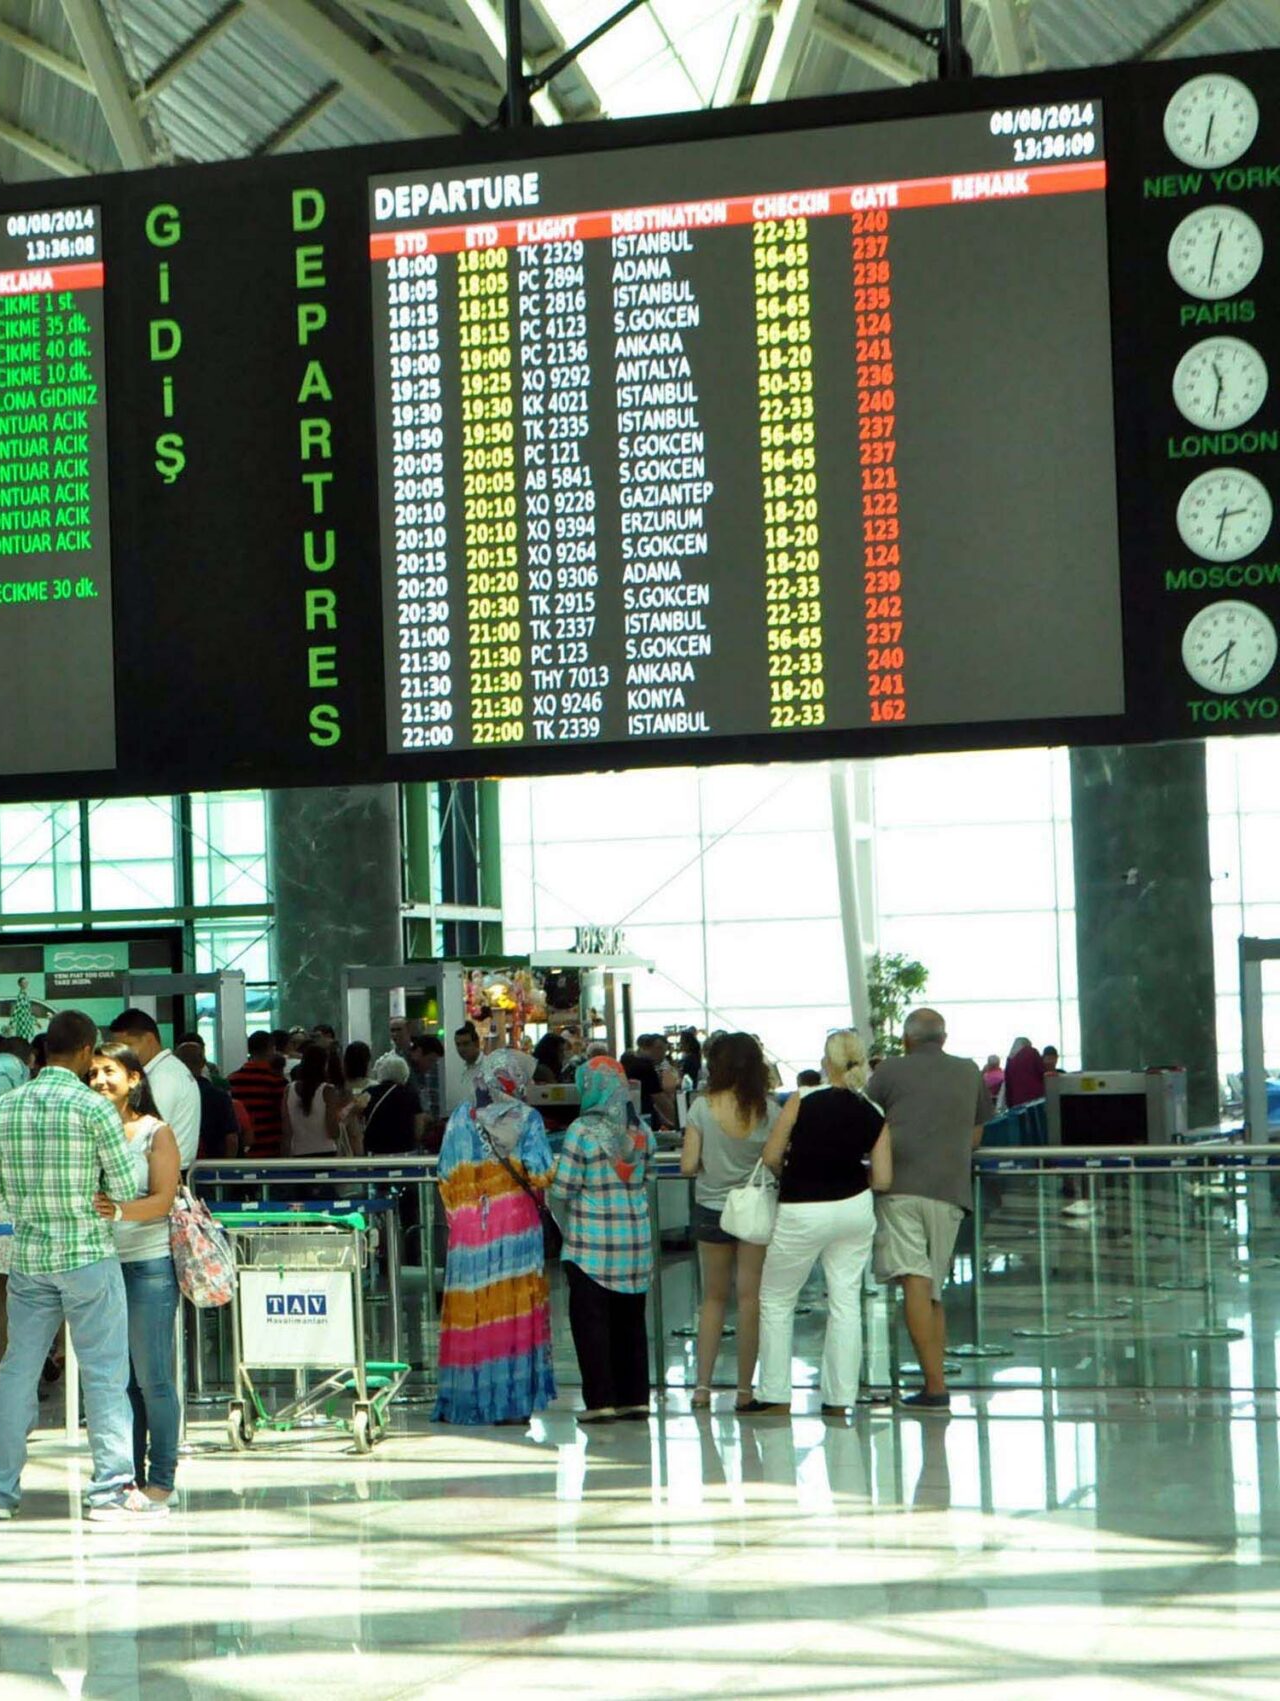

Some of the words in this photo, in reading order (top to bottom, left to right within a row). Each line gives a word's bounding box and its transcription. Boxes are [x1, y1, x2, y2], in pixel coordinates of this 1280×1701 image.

[989, 102, 1095, 136] 08/08/2014
[374, 171, 540, 221] DEPARTURE
[1143, 173, 1202, 199] NEW
[1210, 165, 1280, 193] YORK
[6, 208, 95, 237] 08/08/2014
[515, 217, 580, 242] FLIGHT
[609, 202, 728, 234] DESTINATION
[850, 185, 900, 210] GATE
[950, 172, 1032, 200] REMARK
[387, 278, 438, 304] 18:05
[457, 271, 508, 298] 18:05
[518, 267, 539, 292] PC
[544, 264, 584, 289] 2894
[611, 256, 671, 283] ADANA
[753, 242, 808, 269] 56-65
[851, 233, 888, 261] 237
[1180, 300, 1256, 326] PARIS
[45, 338, 65, 359] 40
[68, 336, 91, 360] dk.
[145, 204, 186, 484] GİDİŞ
[390, 377, 441, 402] 19:25
[461, 371, 511, 396] 19:25
[549, 364, 590, 389] 9292
[615, 355, 691, 383] ANTALYA
[758, 344, 812, 371] 18-20
[855, 337, 892, 364] 241
[52, 409, 88, 431] ACIK
[392, 426, 443, 452] 19:50
[462, 420, 513, 446] 19:50
[521, 418, 544, 441] TK
[548, 414, 589, 439] 2335
[617, 406, 699, 433] ISTANBUL
[759, 395, 813, 422] 22-33
[857, 387, 895, 414] 240
[52, 433, 88, 455] ACIK
[1167, 430, 1278, 459] LONDON
[292, 188, 341, 747] DEPARTURES
[394, 500, 446, 526] 20:10
[464, 495, 516, 520] 20:10
[553, 489, 595, 513] 9228
[619, 481, 713, 508] GAZIANTEP
[762, 471, 816, 498] 18-20
[861, 465, 897, 491] 121
[395, 525, 446, 550] 20:10
[465, 520, 517, 545] 20:10
[554, 515, 595, 539] 9394
[620, 507, 702, 534] ERZURUM
[763, 497, 817, 524] 18-20
[862, 490, 897, 517] 122
[52, 578, 72, 599] 30
[74, 576, 98, 597] dk.
[398, 625, 450, 649] 21:00
[468, 620, 520, 644] 21:00
[528, 619, 551, 640] TK
[555, 615, 595, 639] 2337
[624, 609, 706, 634] ISTANBUL
[766, 600, 821, 625] 22-33
[865, 594, 902, 620] 242
[401, 699, 452, 723] 21:30
[471, 695, 523, 719] 21:30
[561, 691, 602, 714] 9246
[627, 687, 685, 709] KONYA
[770, 677, 824, 702] 18-20
[868, 672, 905, 697] 241
[1187, 698, 1278, 722] TOKYO
[267, 1295, 327, 1315] TAV
